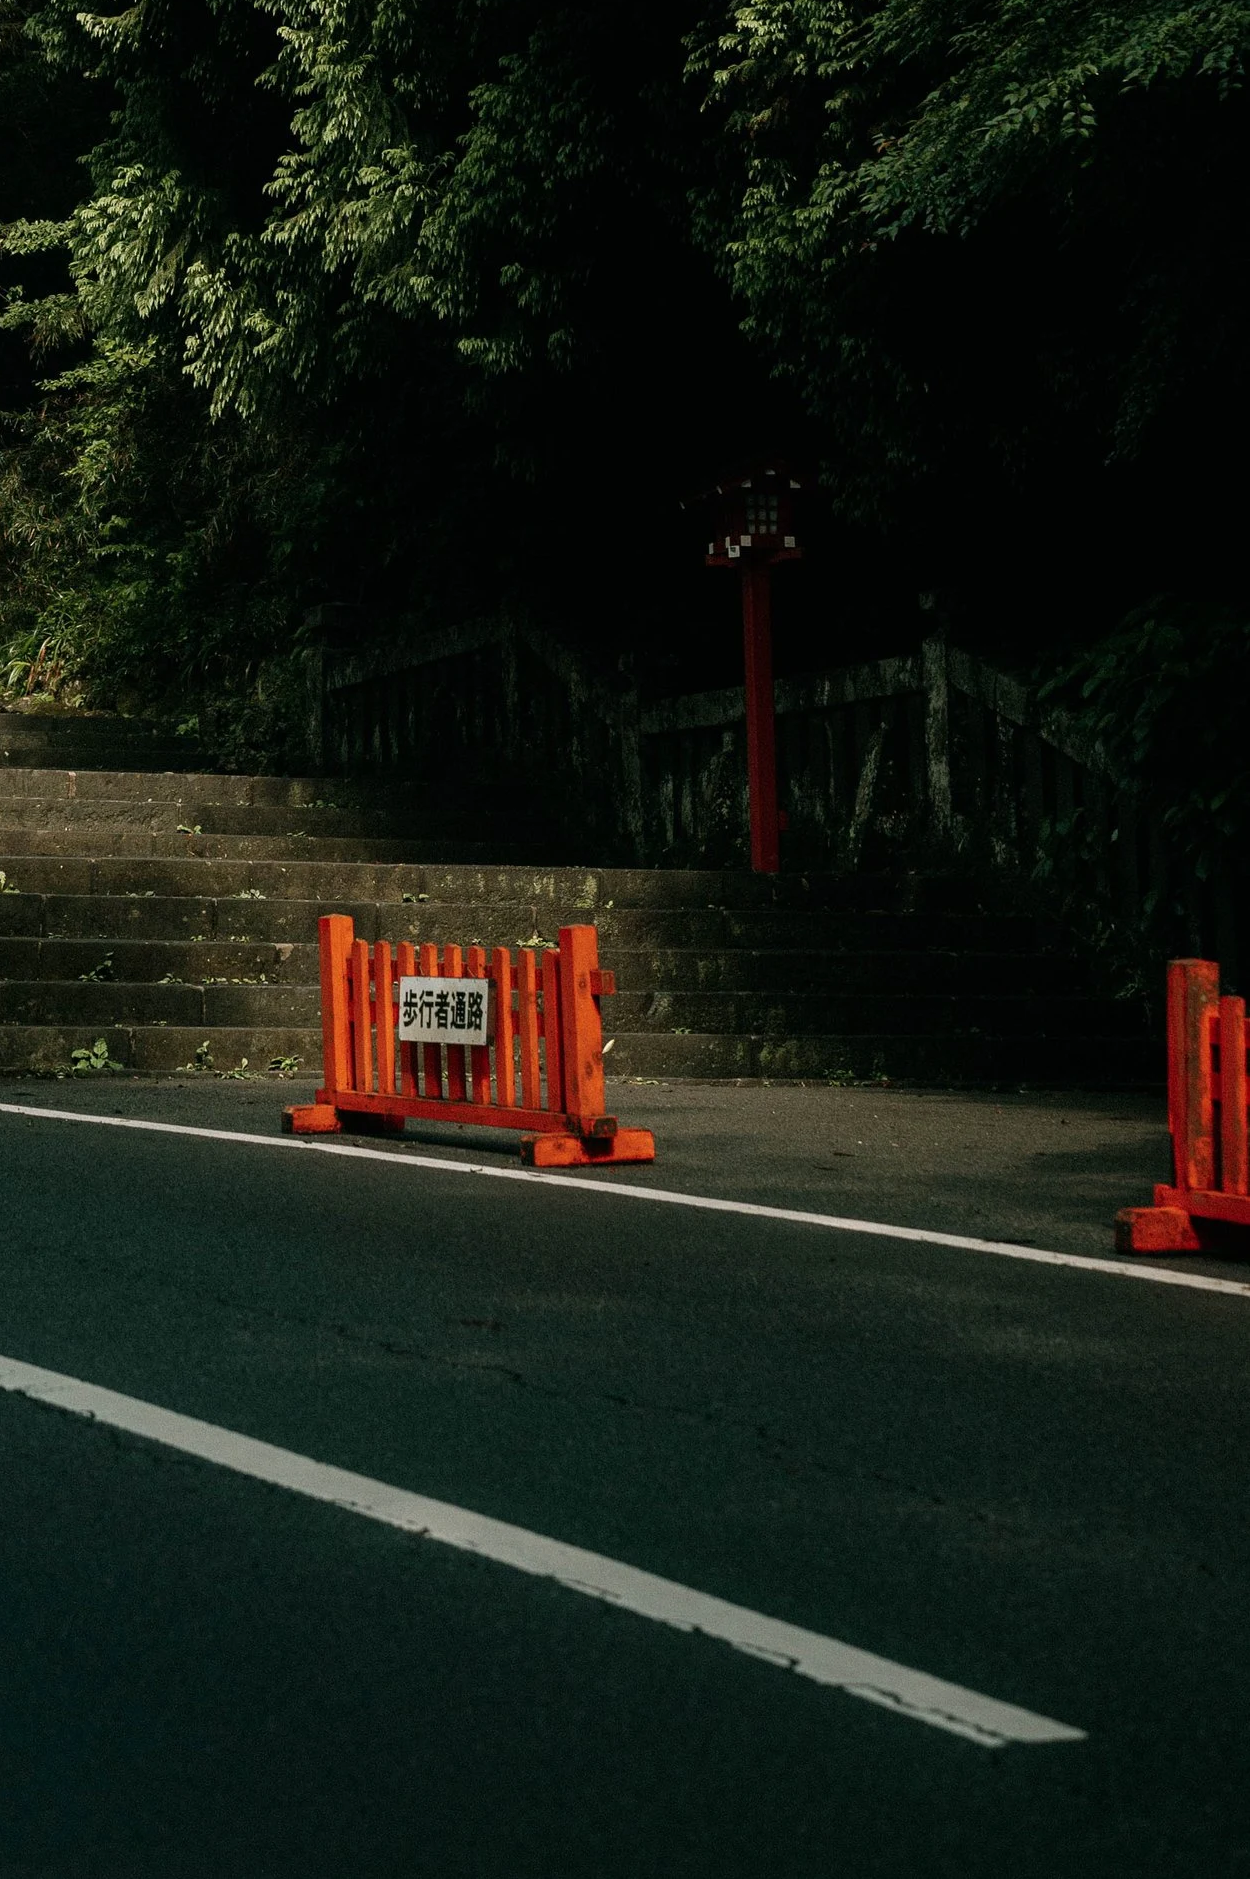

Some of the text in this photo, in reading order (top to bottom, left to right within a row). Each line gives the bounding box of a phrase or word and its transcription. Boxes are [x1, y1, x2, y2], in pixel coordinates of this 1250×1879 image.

[403, 989, 483, 1031] 歩行者通路
